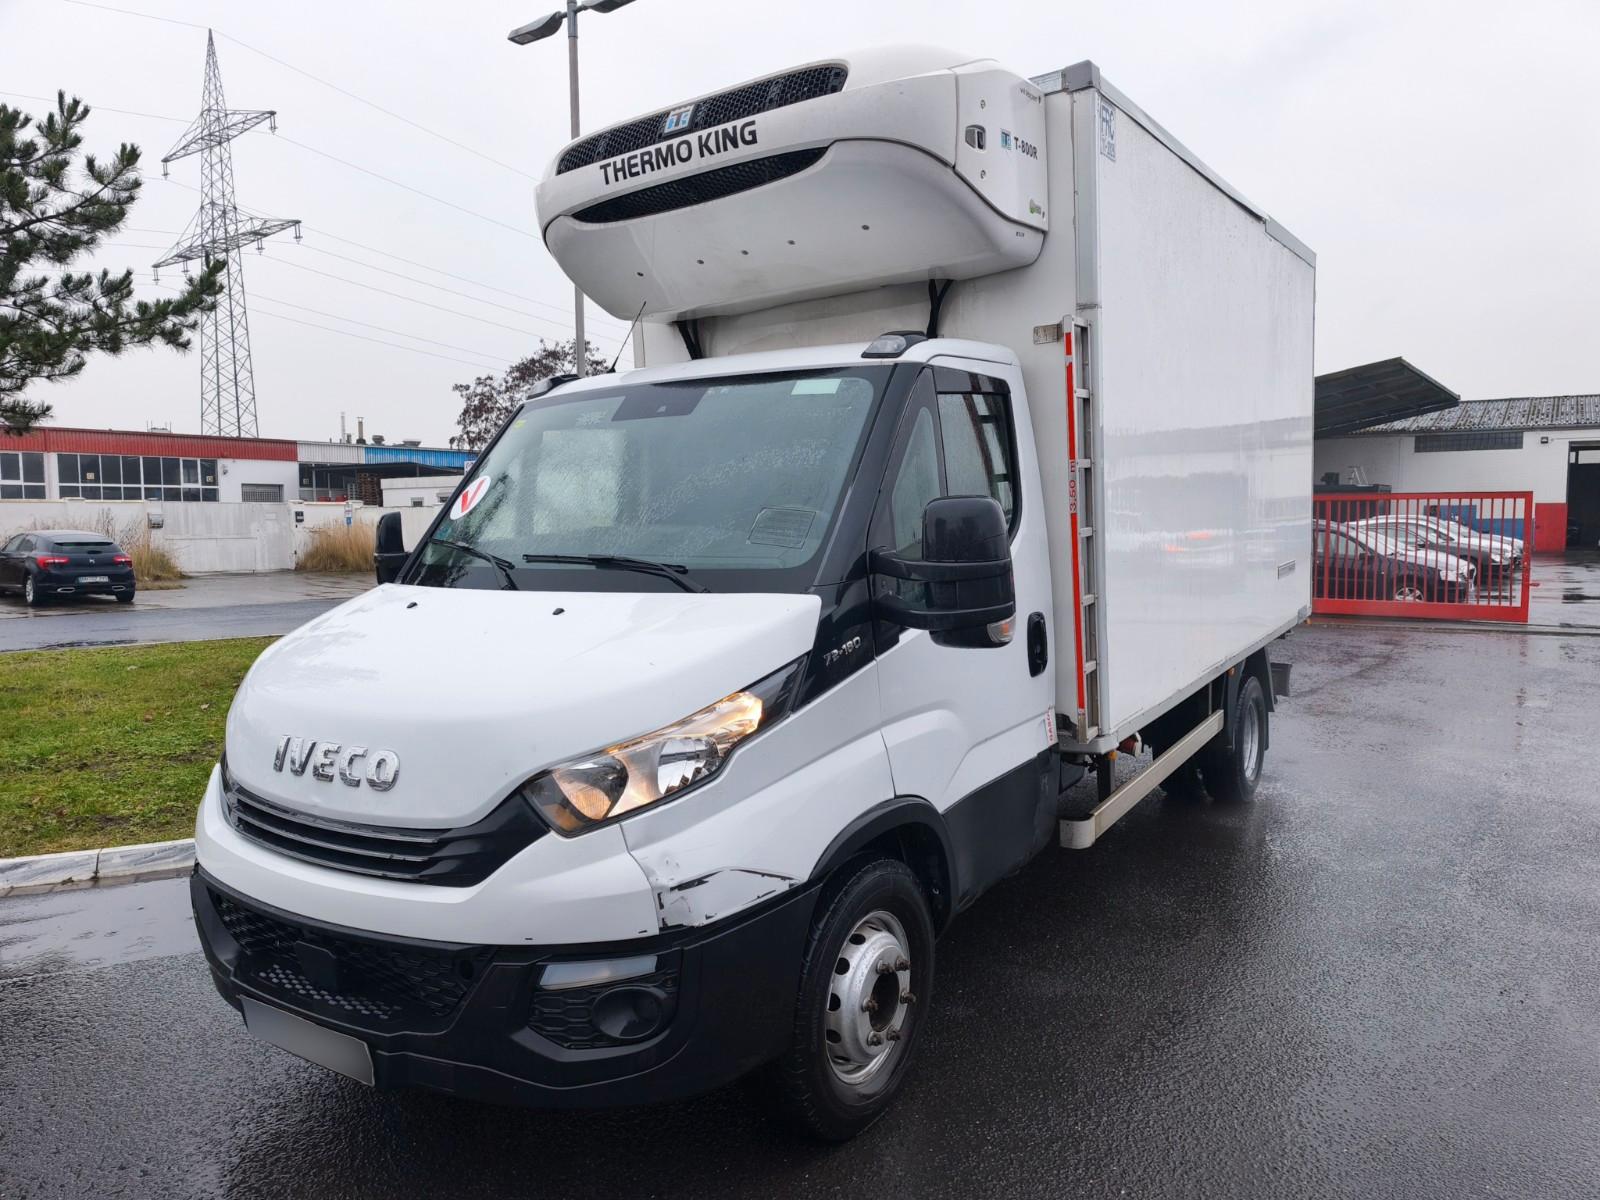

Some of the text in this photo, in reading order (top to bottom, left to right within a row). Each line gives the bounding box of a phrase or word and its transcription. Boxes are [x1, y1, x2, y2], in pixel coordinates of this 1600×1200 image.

[600, 139, 693, 185] THERMO
[697, 120, 758, 158] KING
[1014, 136, 1038, 160] T-800R
[273, 735, 400, 792] IVECO
